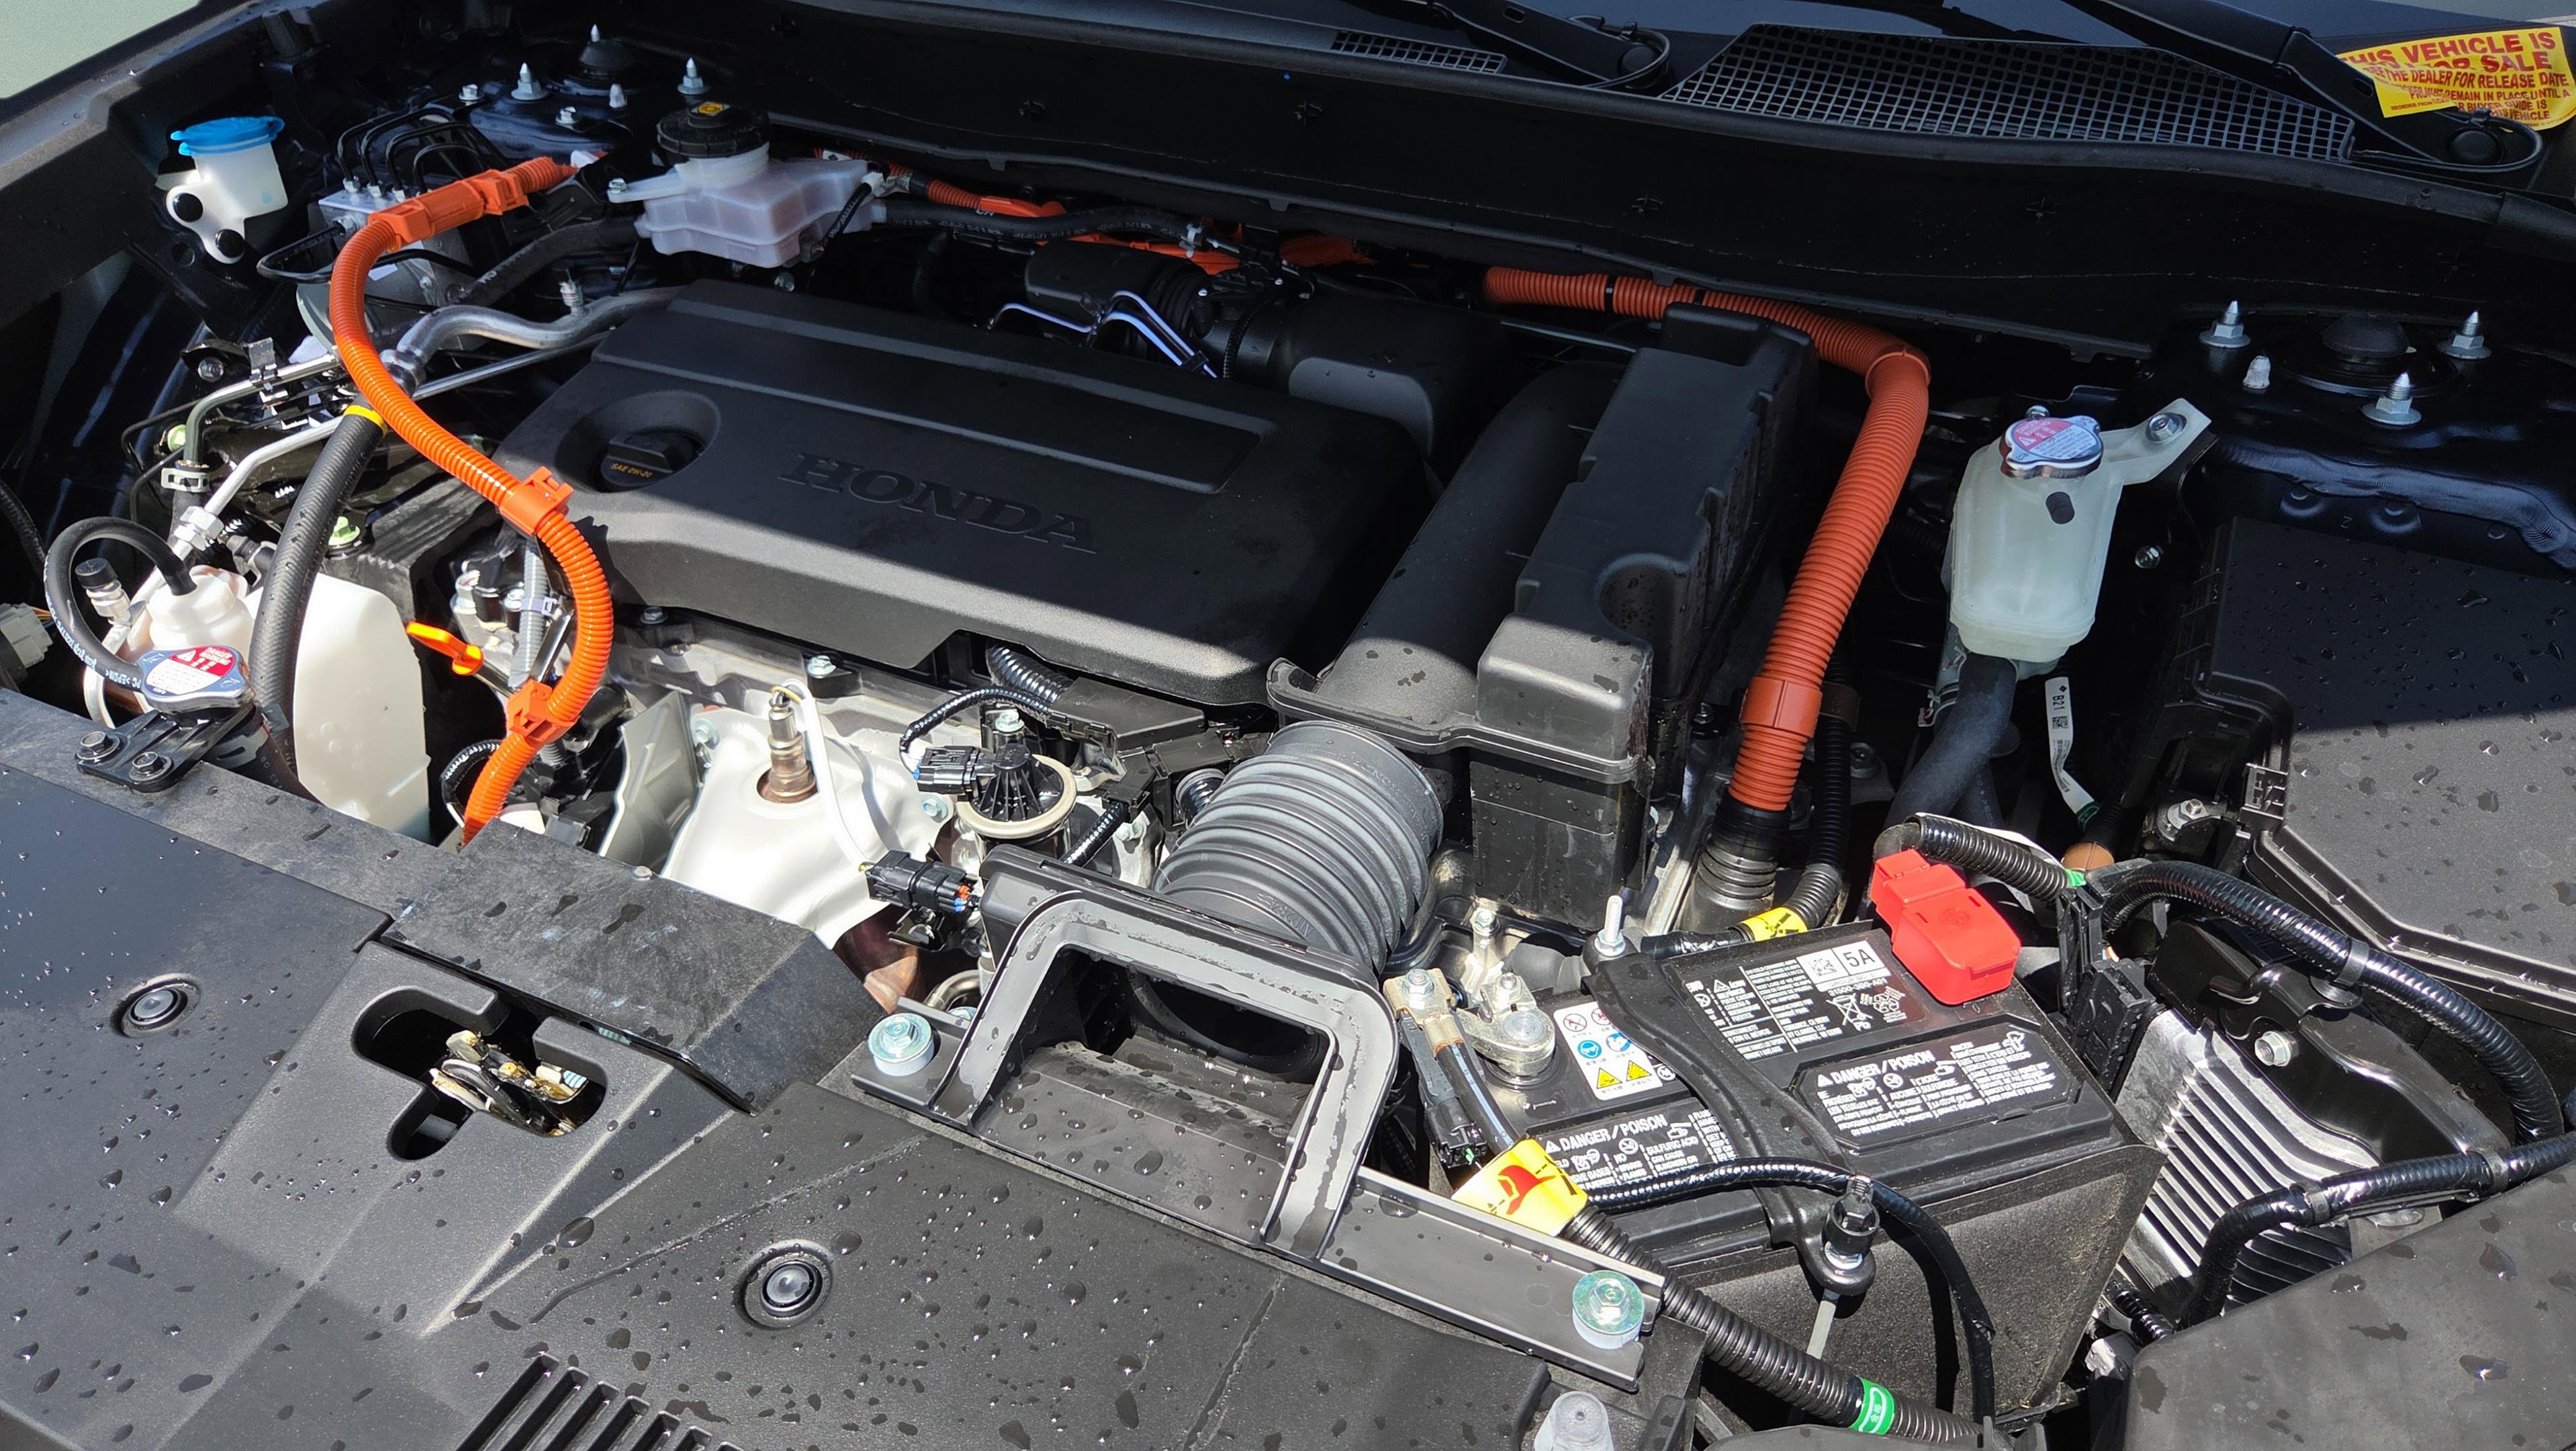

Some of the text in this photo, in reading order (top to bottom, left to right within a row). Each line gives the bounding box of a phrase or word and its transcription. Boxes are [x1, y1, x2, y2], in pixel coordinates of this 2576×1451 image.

[2401, 34, 2523, 63] VEHICLE
[2528, 32, 2556, 49] IS
[2481, 51, 2552, 73] SALE
[2386, 69, 2409, 82] THE
[2411, 70, 2452, 86] DEALER
[2453, 71, 2475, 88] FOR
[2478, 73, 2536, 89] RELEASE
[2539, 72, 2569, 87] DATE
[2483, 91, 2493, 100] IN
[2497, 91, 2530, 100] PLACE
[2530, 88, 2560, 100] UNTIL
[2563, 89, 2571, 97] A
[2536, 99, 2546, 109] IS
[2510, 109, 2550, 120] VEHICLE
[611, 462, 629, 472] SAE
[779, 453, 1100, 554] HONDA
[2052, 695, 2066, 711] B21
[1843, 949, 1876, 967] 5A
[1853, 1021, 1872, 1031] Pb
[1614, 1153, 1626, 1164] NO
